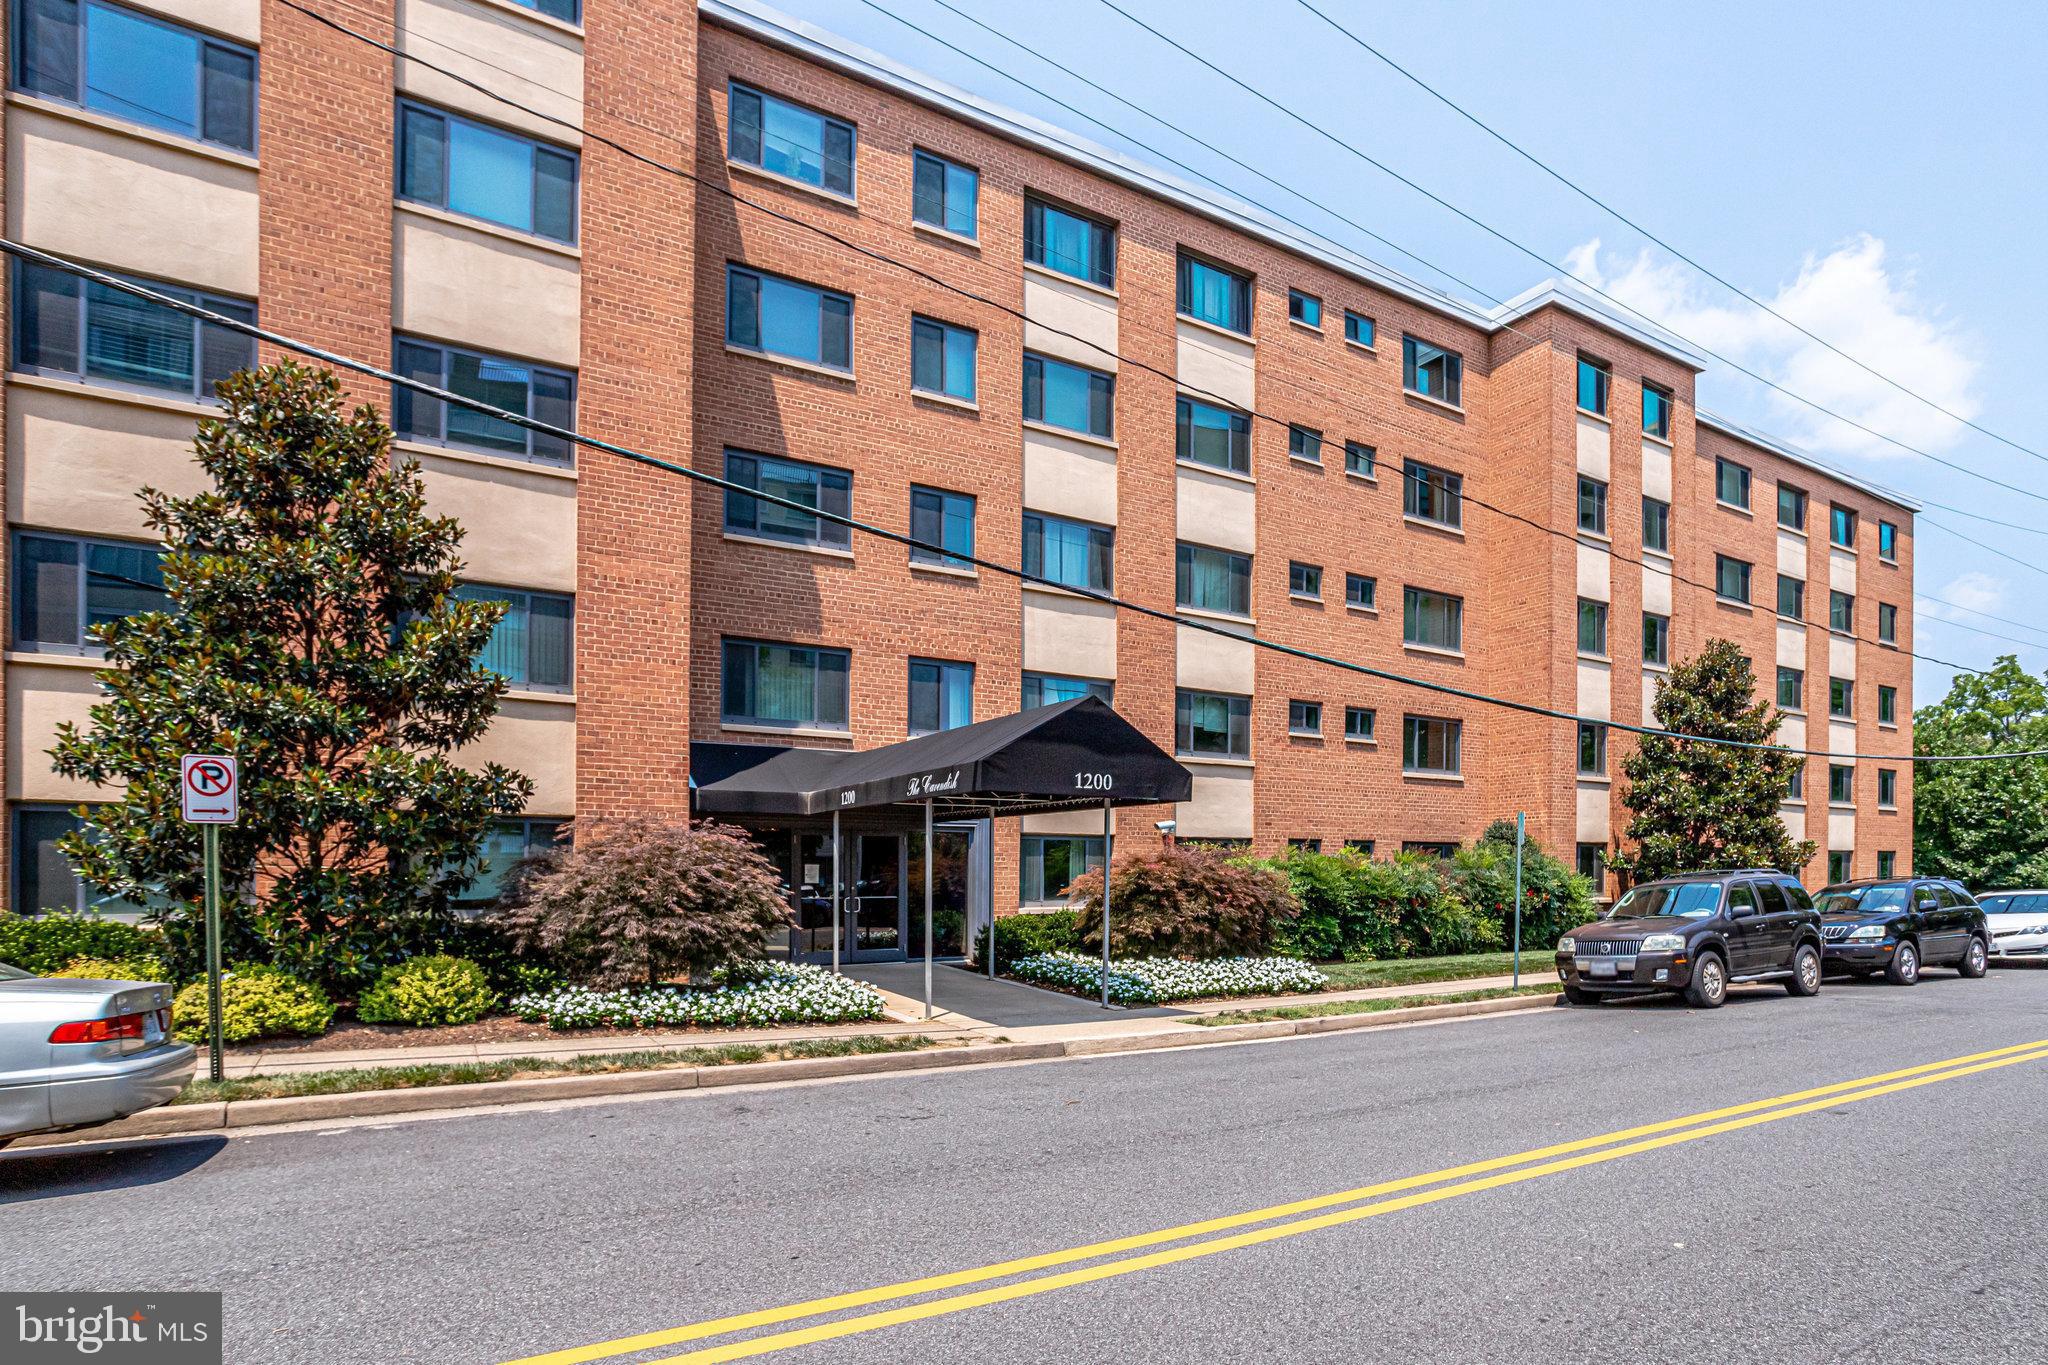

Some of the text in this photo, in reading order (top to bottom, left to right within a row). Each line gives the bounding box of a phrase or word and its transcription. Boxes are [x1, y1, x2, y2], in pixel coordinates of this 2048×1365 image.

[201, 765, 223, 789] P
[907, 770, 960, 797] The Cavendish
[1074, 772, 1113, 790] 1200
[841, 790, 856, 806] 1200
